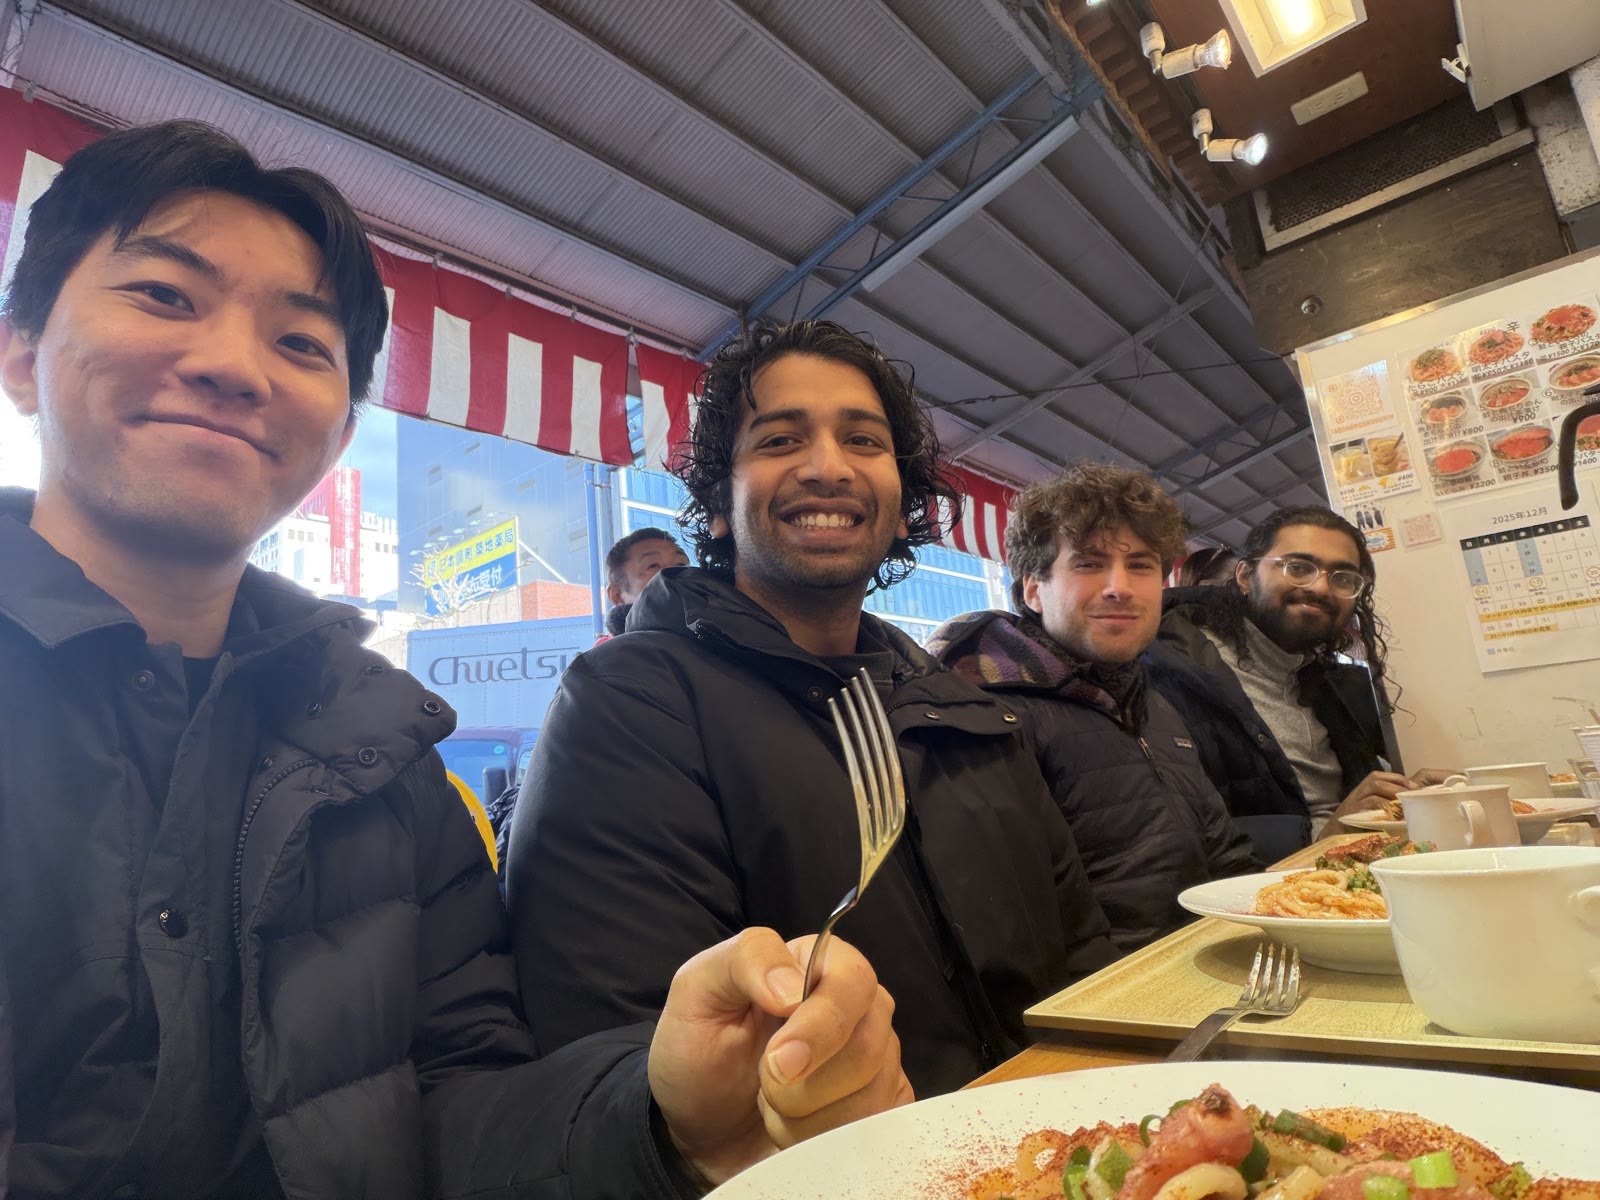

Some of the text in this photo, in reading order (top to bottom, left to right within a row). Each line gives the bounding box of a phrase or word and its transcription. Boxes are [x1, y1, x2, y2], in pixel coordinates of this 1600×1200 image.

[1512, 412, 1537, 424] ¥900
[1462, 425, 1484, 436] ¥800
[1470, 478, 1497, 490] ¥3200
[1491, 506, 1549, 525] 2025年12月
[475, 528, 513, 556] 築地薬局
